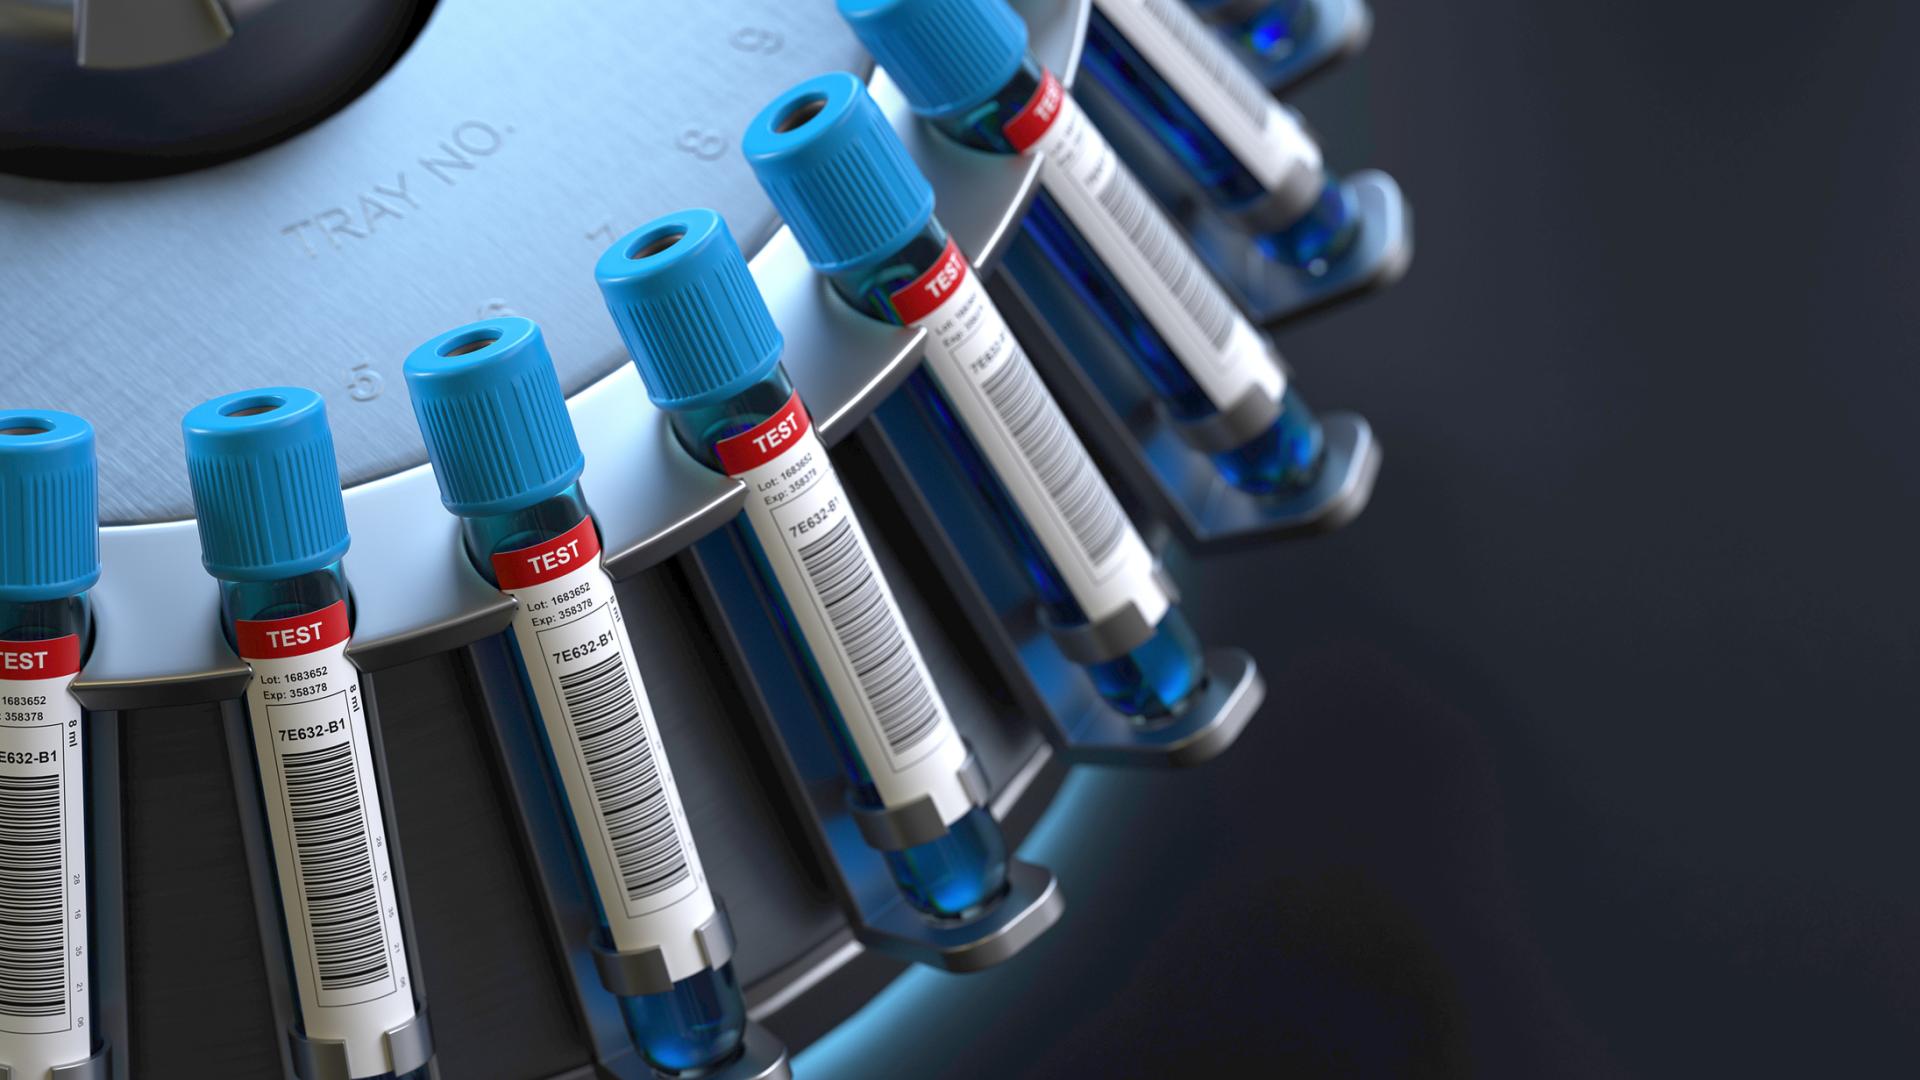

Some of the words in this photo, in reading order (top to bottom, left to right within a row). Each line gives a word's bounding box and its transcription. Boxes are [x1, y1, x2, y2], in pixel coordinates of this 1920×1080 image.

[675, 129, 729, 162] 8
[280, 172, 420, 259] TRAY
[417, 119, 516, 186] NO.
[347, 362, 385, 403] 5
[752, 411, 798, 453] TEST
[757, 477, 779, 492] Lot:
[763, 490, 788, 505] Exp:
[527, 539, 579, 574] TEST
[527, 601, 549, 612] Lot:
[550, 582, 591, 606] 1683652
[531, 614, 557, 627] Exp:
[558, 598, 593, 620] 358378
[266, 621, 322, 648] TEST
[553, 629, 614, 664] 7E632-B1
[0, 651, 48, 670] EST
[261, 674, 281, 685] Lot:
[284, 666, 328, 683] 1683652
[263, 690, 287, 701] Exp:
[289, 682, 328, 698] 358378
[349, 684, 357, 693] 8
[2, 695, 47, 706] 1683652
[5, 712, 44, 721] 358378
[68, 719, 78, 728] 8
[68, 731, 78, 747] ml
[279, 718, 346, 742] 7E632-B1
[73, 873, 81, 886] 28
[74, 908, 82, 920] 16
[75, 945, 83, 957] 35
[76, 982, 84, 993] 21
